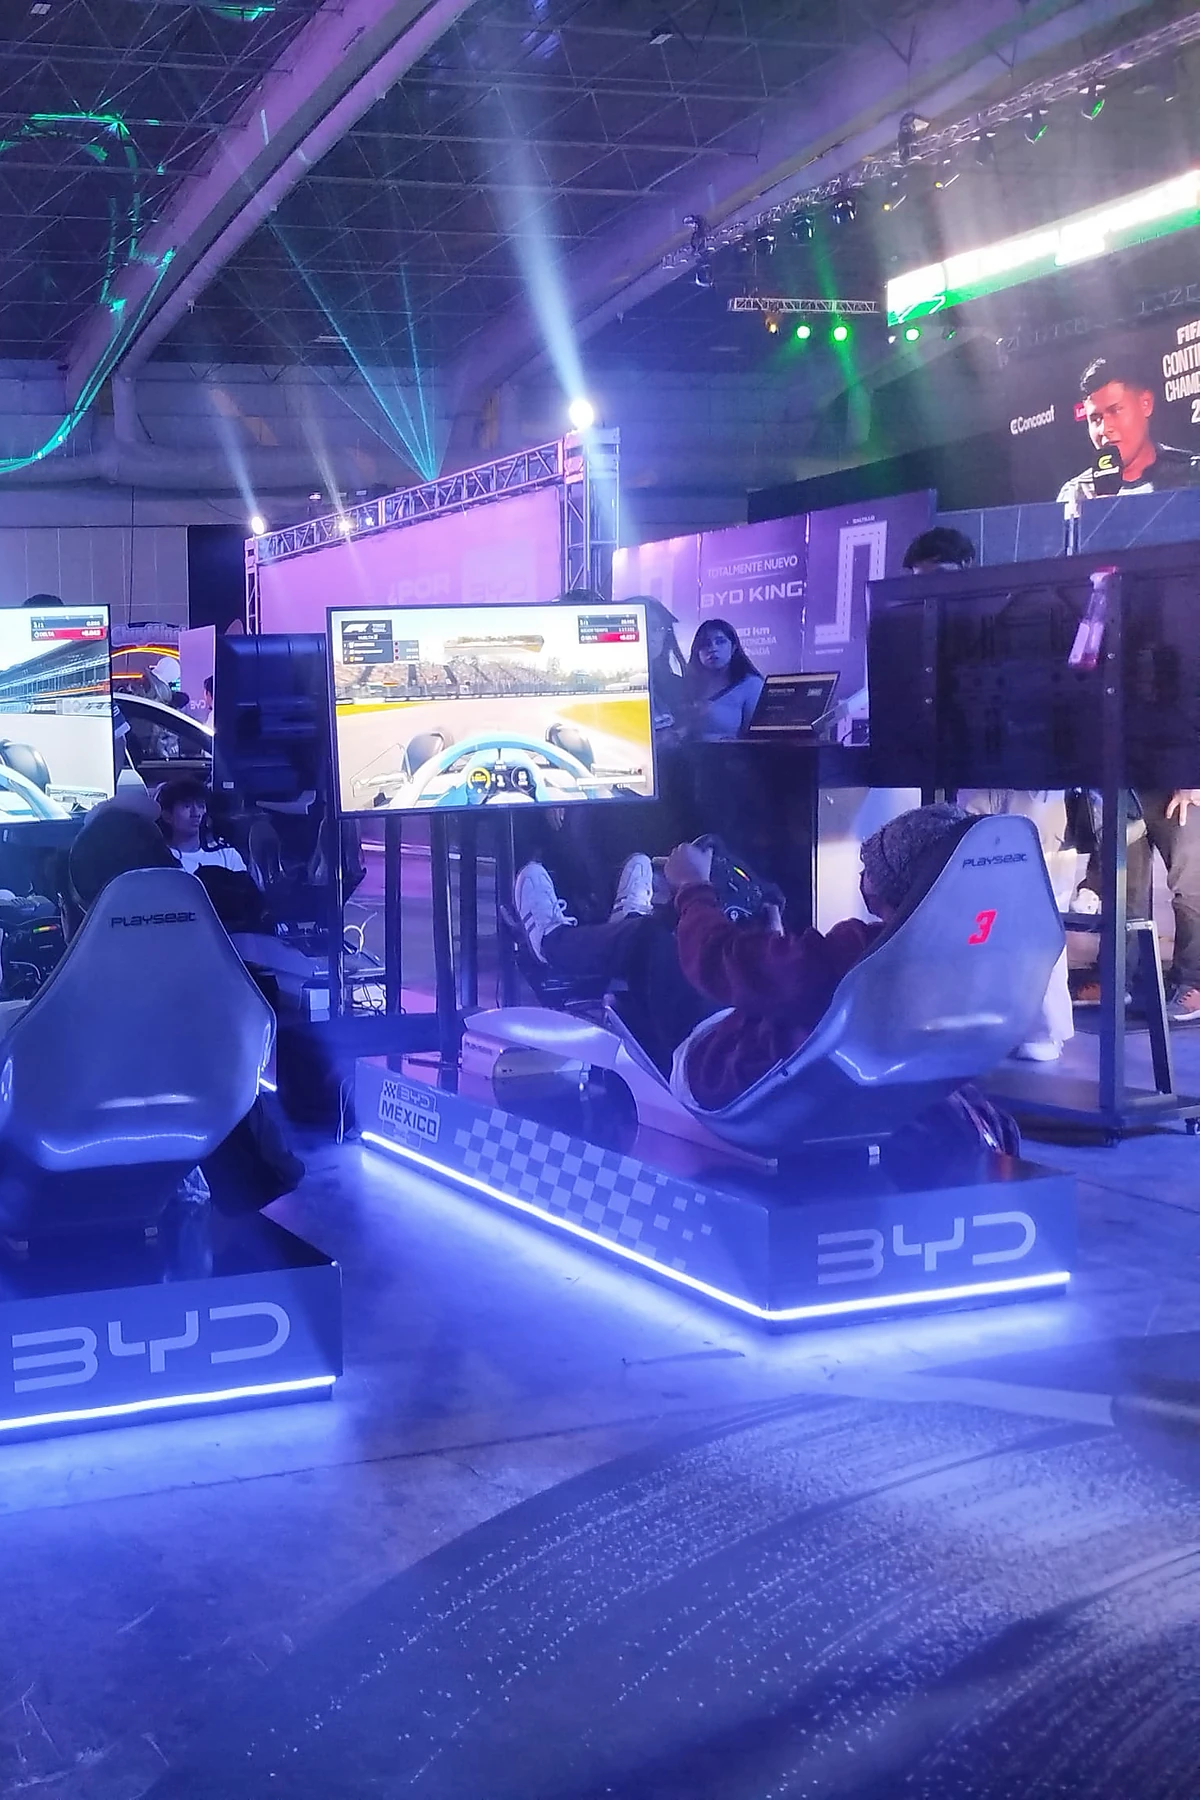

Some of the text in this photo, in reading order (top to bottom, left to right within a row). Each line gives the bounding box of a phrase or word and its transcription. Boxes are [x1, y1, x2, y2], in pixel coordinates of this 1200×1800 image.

[1018, 404, 1055, 433] Concacaf
[708, 554, 798, 578] TOTALMENTE NUEVO
[700, 580, 803, 609] BYD KING
[967, 909, 998, 946] 3
[400, 1086, 430, 1109] BYD
[381, 1100, 438, 1137] MEXICO
[817, 1211, 1037, 1285] BYD
[12, 1301, 291, 1394] BYD
